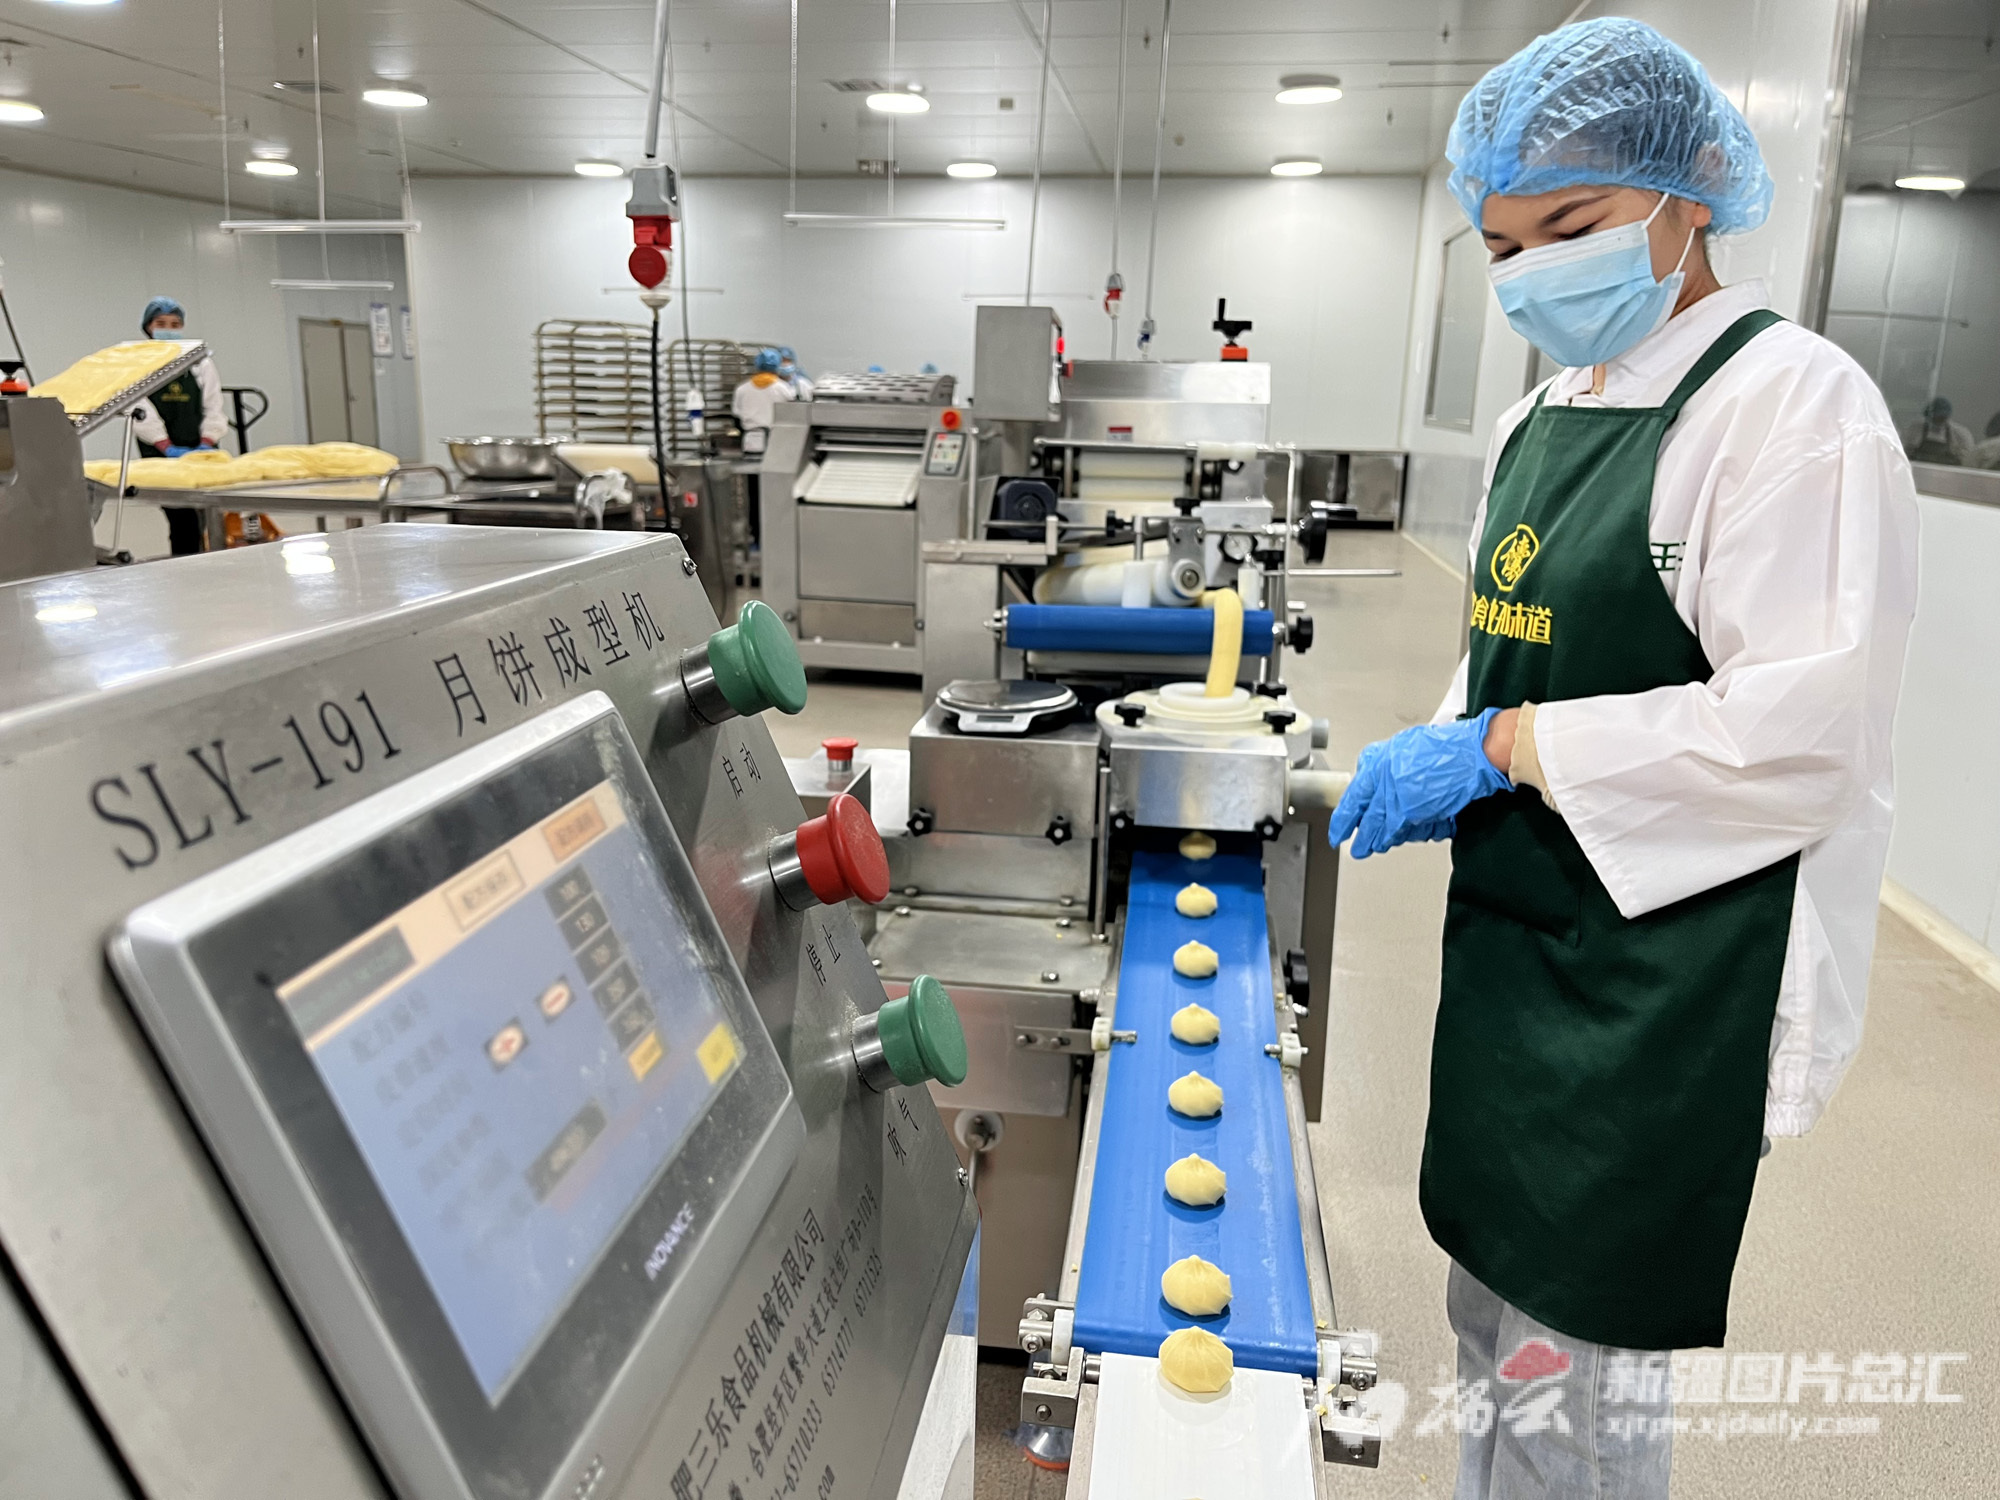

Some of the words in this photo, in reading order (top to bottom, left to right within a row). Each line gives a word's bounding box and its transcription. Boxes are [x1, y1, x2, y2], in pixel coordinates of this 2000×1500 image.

[89, 690, 401, 872] SLY-191
[434, 591, 666, 738] 月饼成型机
[722, 741, 762, 800] 启动
[805, 924, 841, 987] 停止
[643, 1201, 695, 1281] INOVANCE
[769, 1398, 822, 1500] 1-65710333
